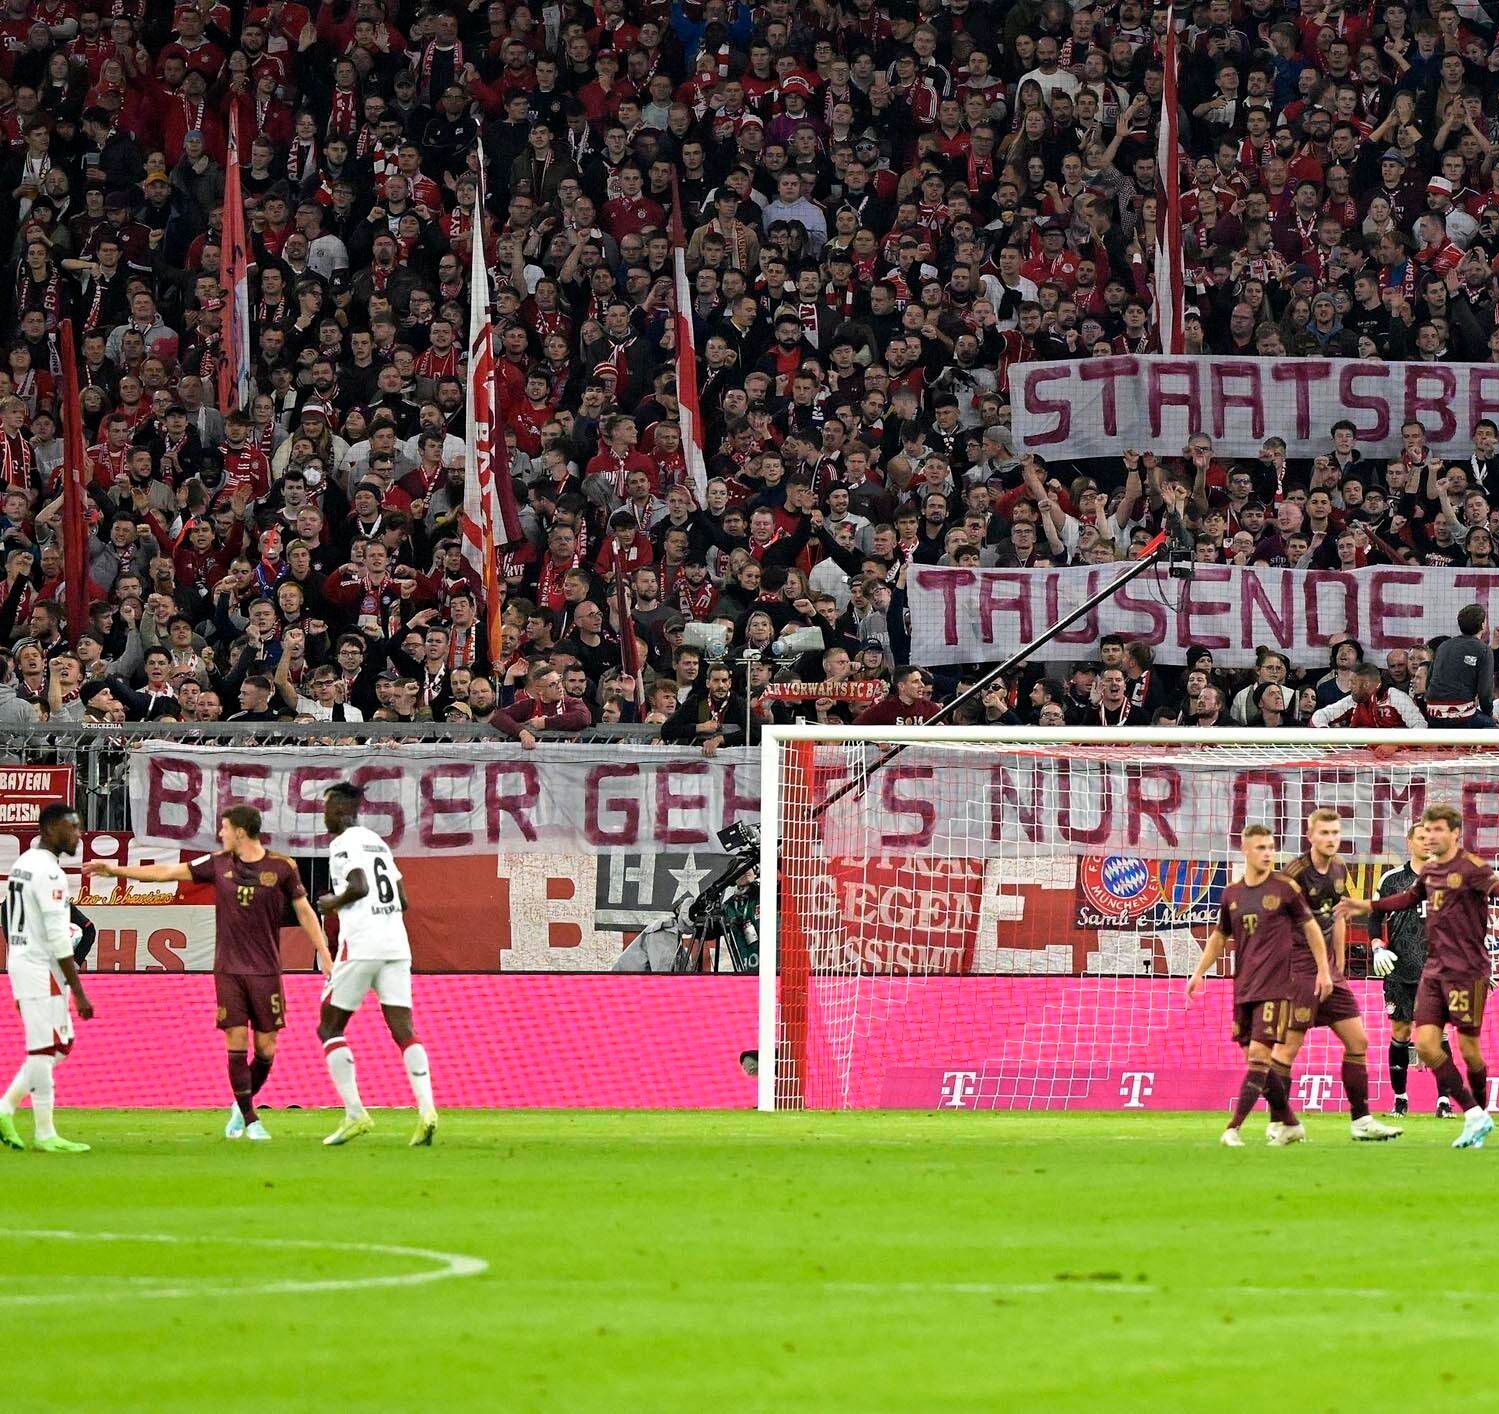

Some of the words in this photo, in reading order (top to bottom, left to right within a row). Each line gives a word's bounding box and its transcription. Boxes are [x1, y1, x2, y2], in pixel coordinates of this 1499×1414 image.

[916, 567, 1425, 651] TAUSENDE
[146, 757, 540, 847] BESSER
[988, 764, 1185, 847] NUR
[373, 856, 395, 904] 6
[812, 874, 974, 931] GEGEN
[270, 993, 280, 1015] 5
[1262, 1001, 1275, 1023] 6
[1448, 990, 1470, 1013] 25
